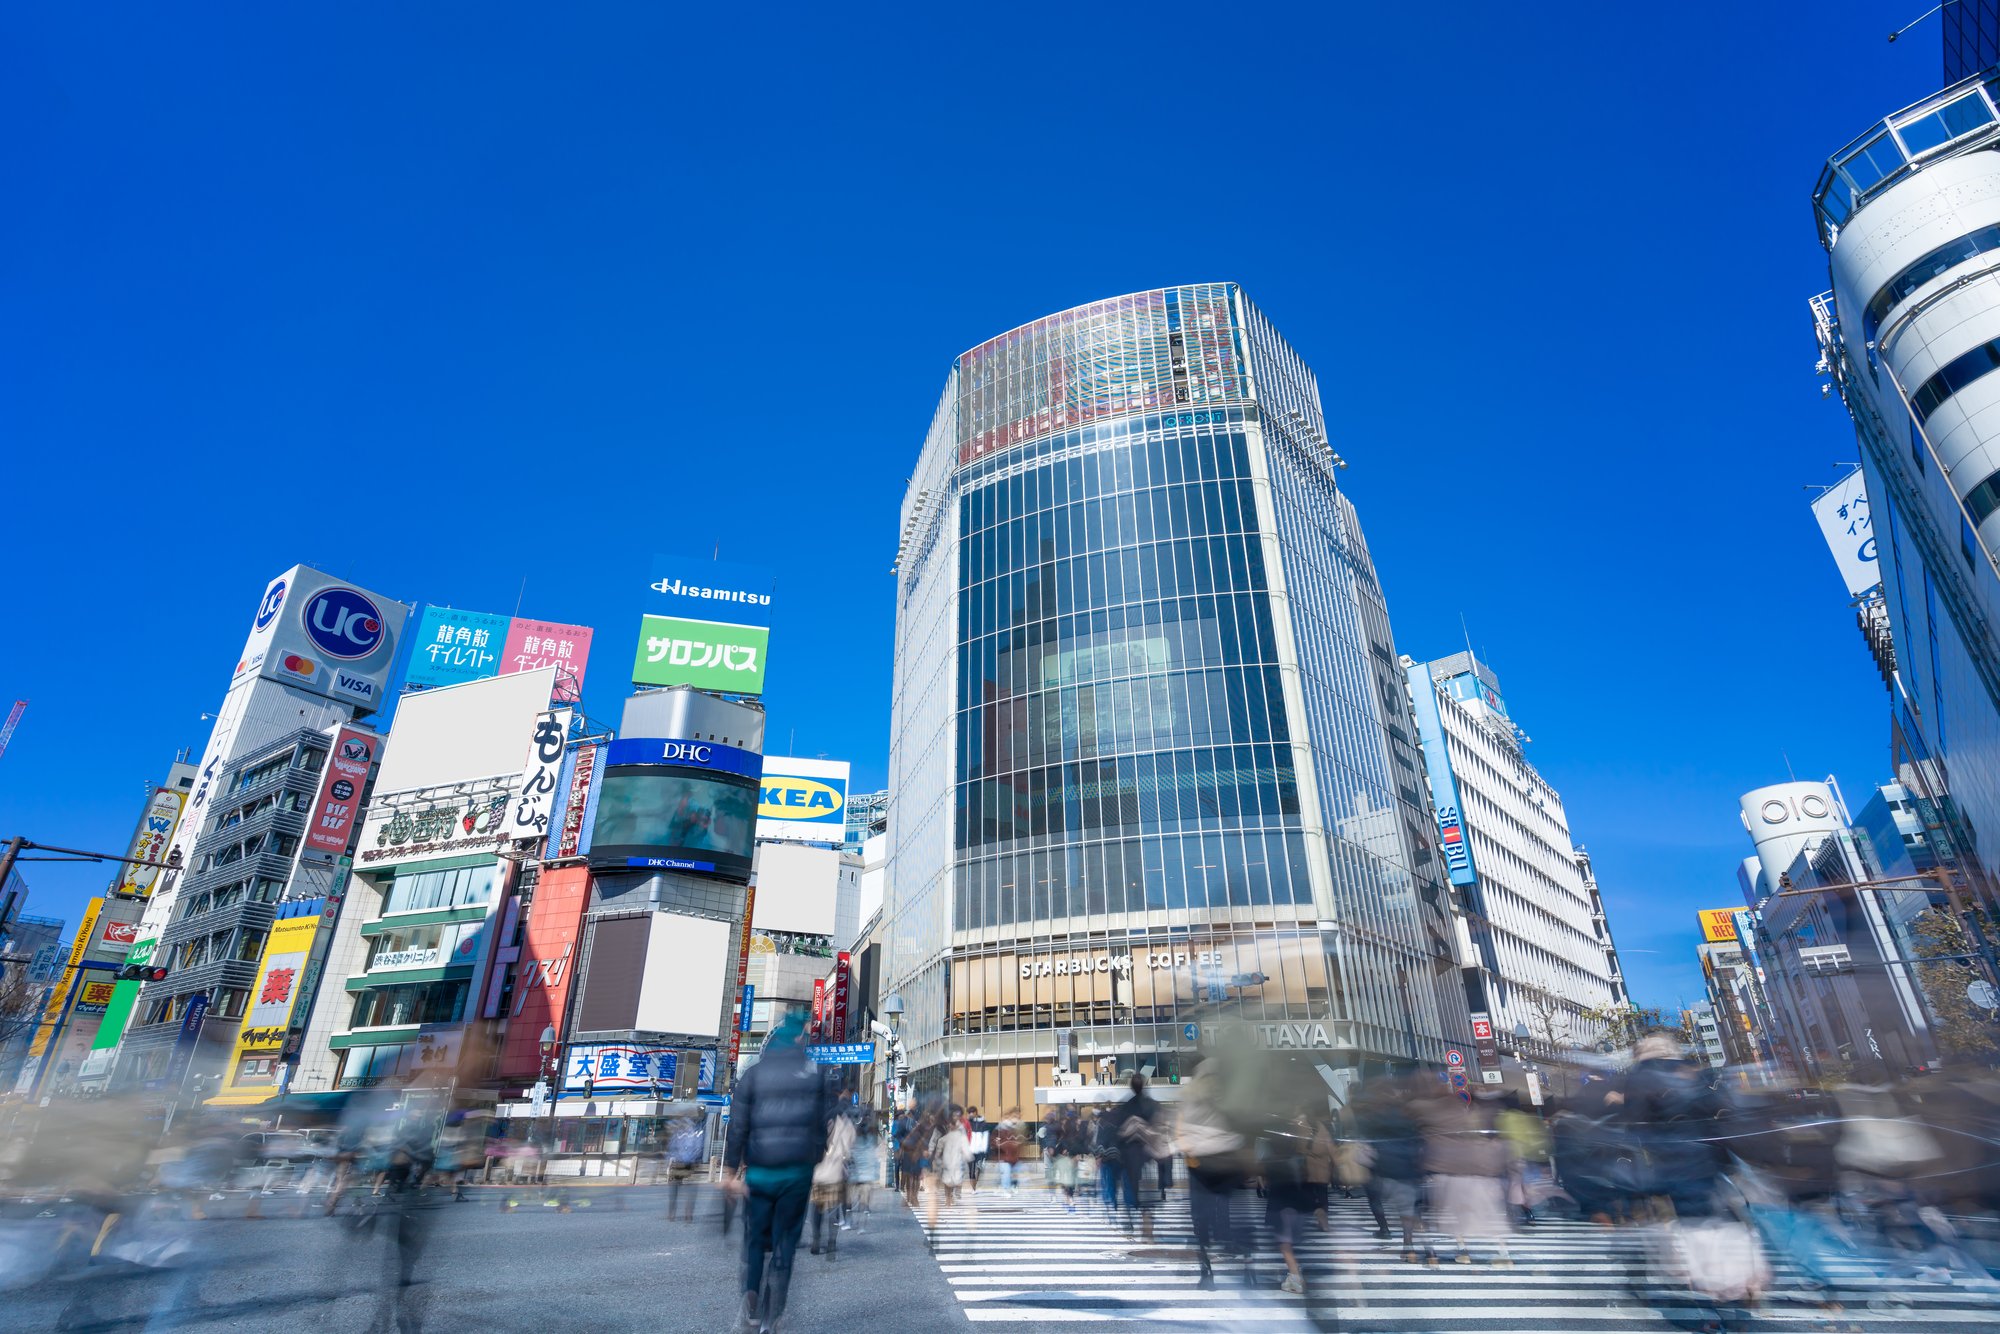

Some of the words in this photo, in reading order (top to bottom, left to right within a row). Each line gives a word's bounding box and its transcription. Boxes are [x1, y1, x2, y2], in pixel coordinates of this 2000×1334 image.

[1166, 412, 1221, 426] QFRONT
[259, 589, 284, 618] UC
[651, 578, 770, 605] Hisamitsu
[313, 598, 374, 645] UC
[436, 624, 490, 647] 龍角散
[523, 635, 574, 659] 龍角散
[425, 643, 494, 668] ダイレクト
[647, 636, 757, 672] サロンパス
[339, 674, 372, 695] VISA
[663, 742, 711, 763] DHC
[516, 713, 564, 833] もんじゃ
[759, 787, 834, 809] KEA
[1371, 640, 1460, 978] TSUTAYA
[648, 858, 665, 866] DHC
[666, 859, 695, 868] Channel
[274, 924, 304, 933] Matsumoto
[1712, 925, 1735, 938] REC
[1022, 954, 1134, 978] STARBUCKS
[261, 968, 295, 1004] 薬
[513, 941, 574, 1017] クスリ
[836, 959, 848, 1011] カラオケ
[189, 1003, 203, 1030] MIZUHO
[1203, 1024, 1331, 1048] TTAYA
[1476, 1023, 1489, 1035] 本
